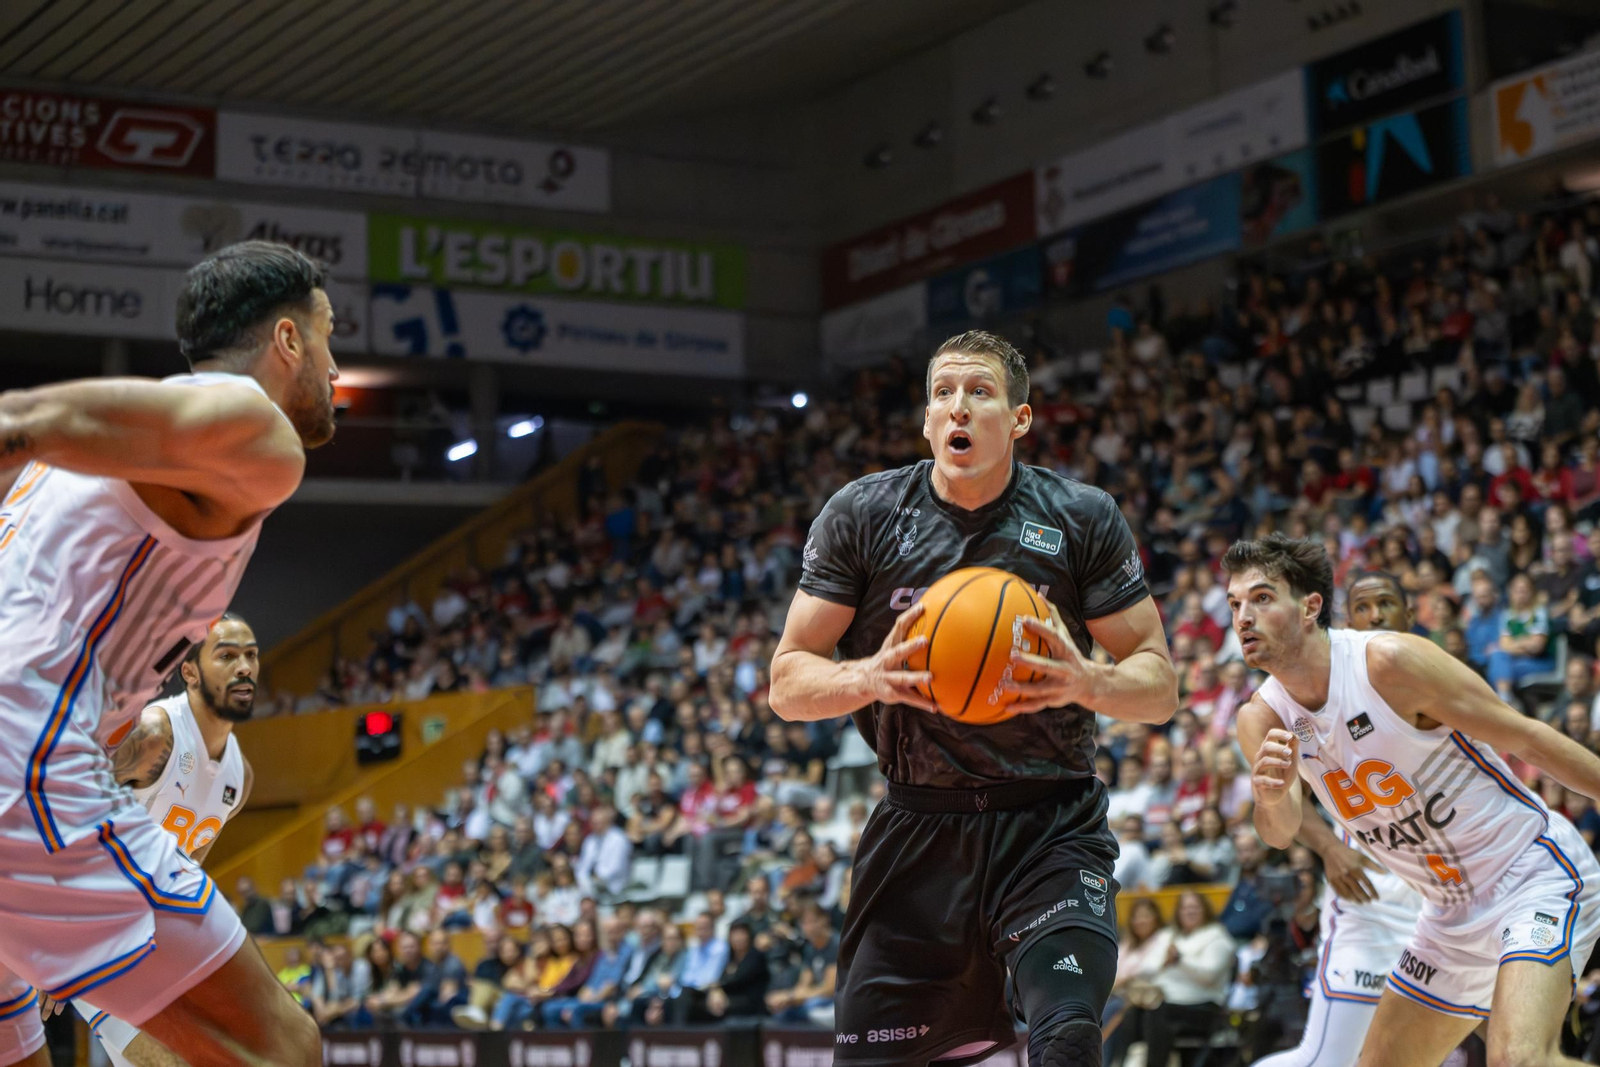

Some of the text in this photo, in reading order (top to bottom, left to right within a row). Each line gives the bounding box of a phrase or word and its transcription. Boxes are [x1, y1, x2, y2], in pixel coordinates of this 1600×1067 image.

[400, 225, 715, 301] L'ESPORTIU
[23, 277, 143, 319] Home
[1321, 758, 1418, 823] BG
[1083, 876, 1102, 888] acb
[1424, 853, 1465, 888] 4
[1053, 962, 1084, 975] adidas
[866, 1026, 917, 1043] asisa
